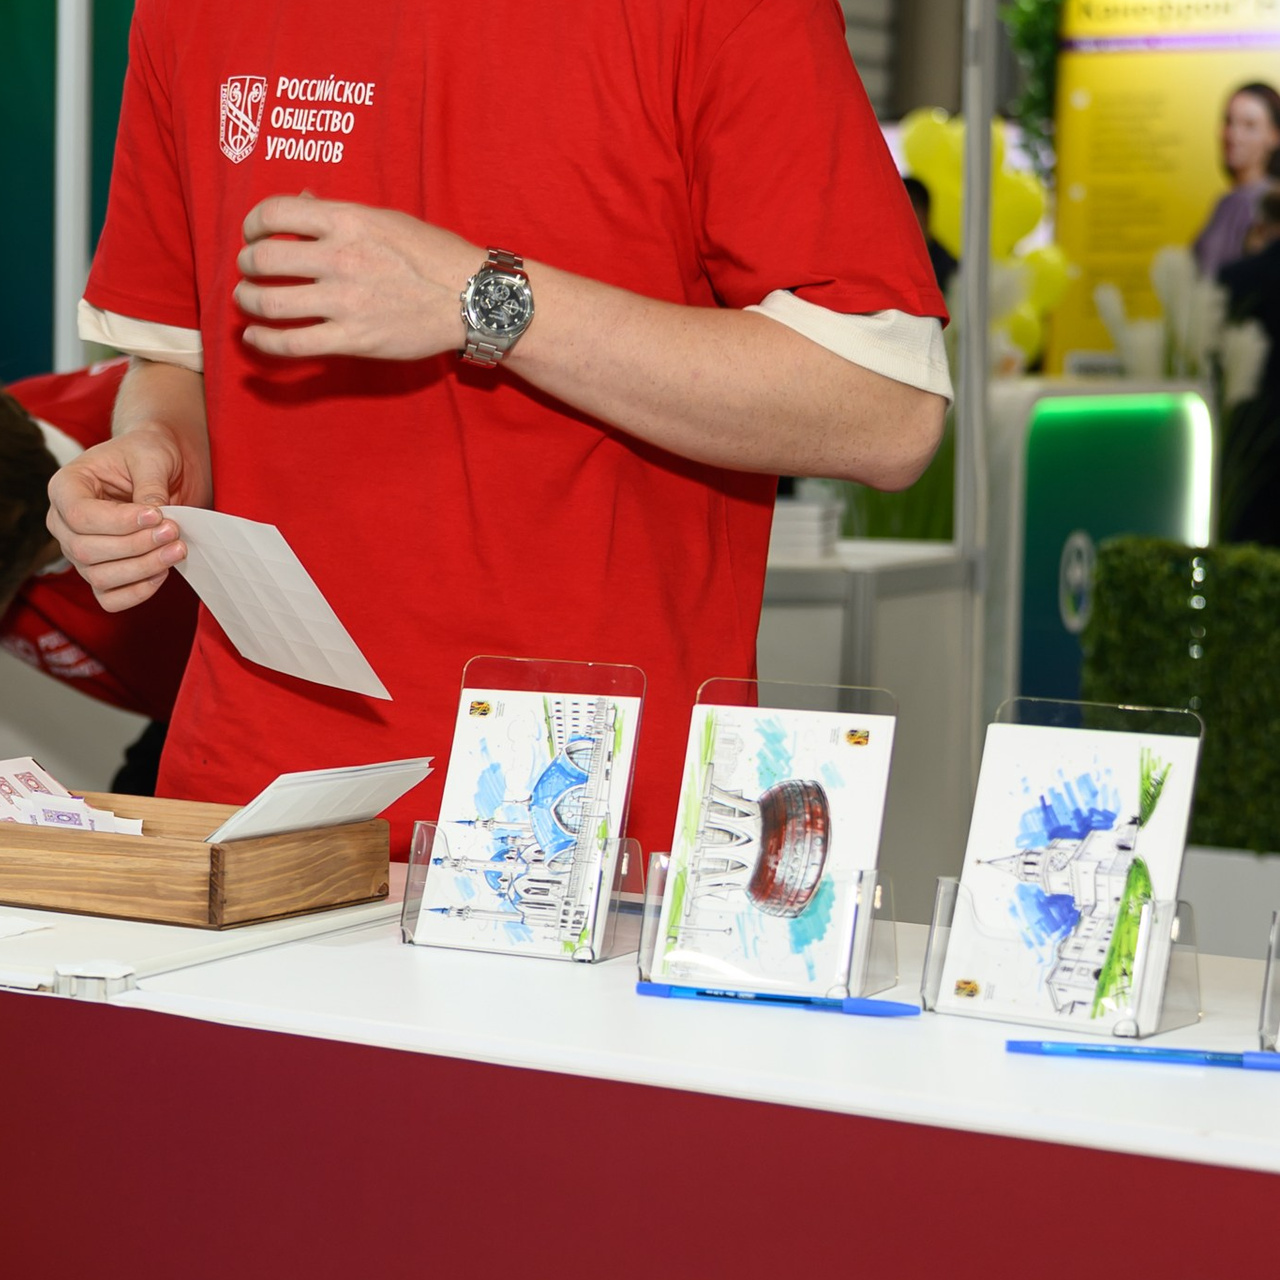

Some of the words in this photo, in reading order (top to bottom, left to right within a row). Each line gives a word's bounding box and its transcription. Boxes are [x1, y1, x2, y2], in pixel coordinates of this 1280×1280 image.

[276, 74, 376, 106] РОССИЙСКОЕ
[271, 107, 355, 135] ОБЩЕСТВО
[265, 136, 344, 164] УРОЛОГОВ
